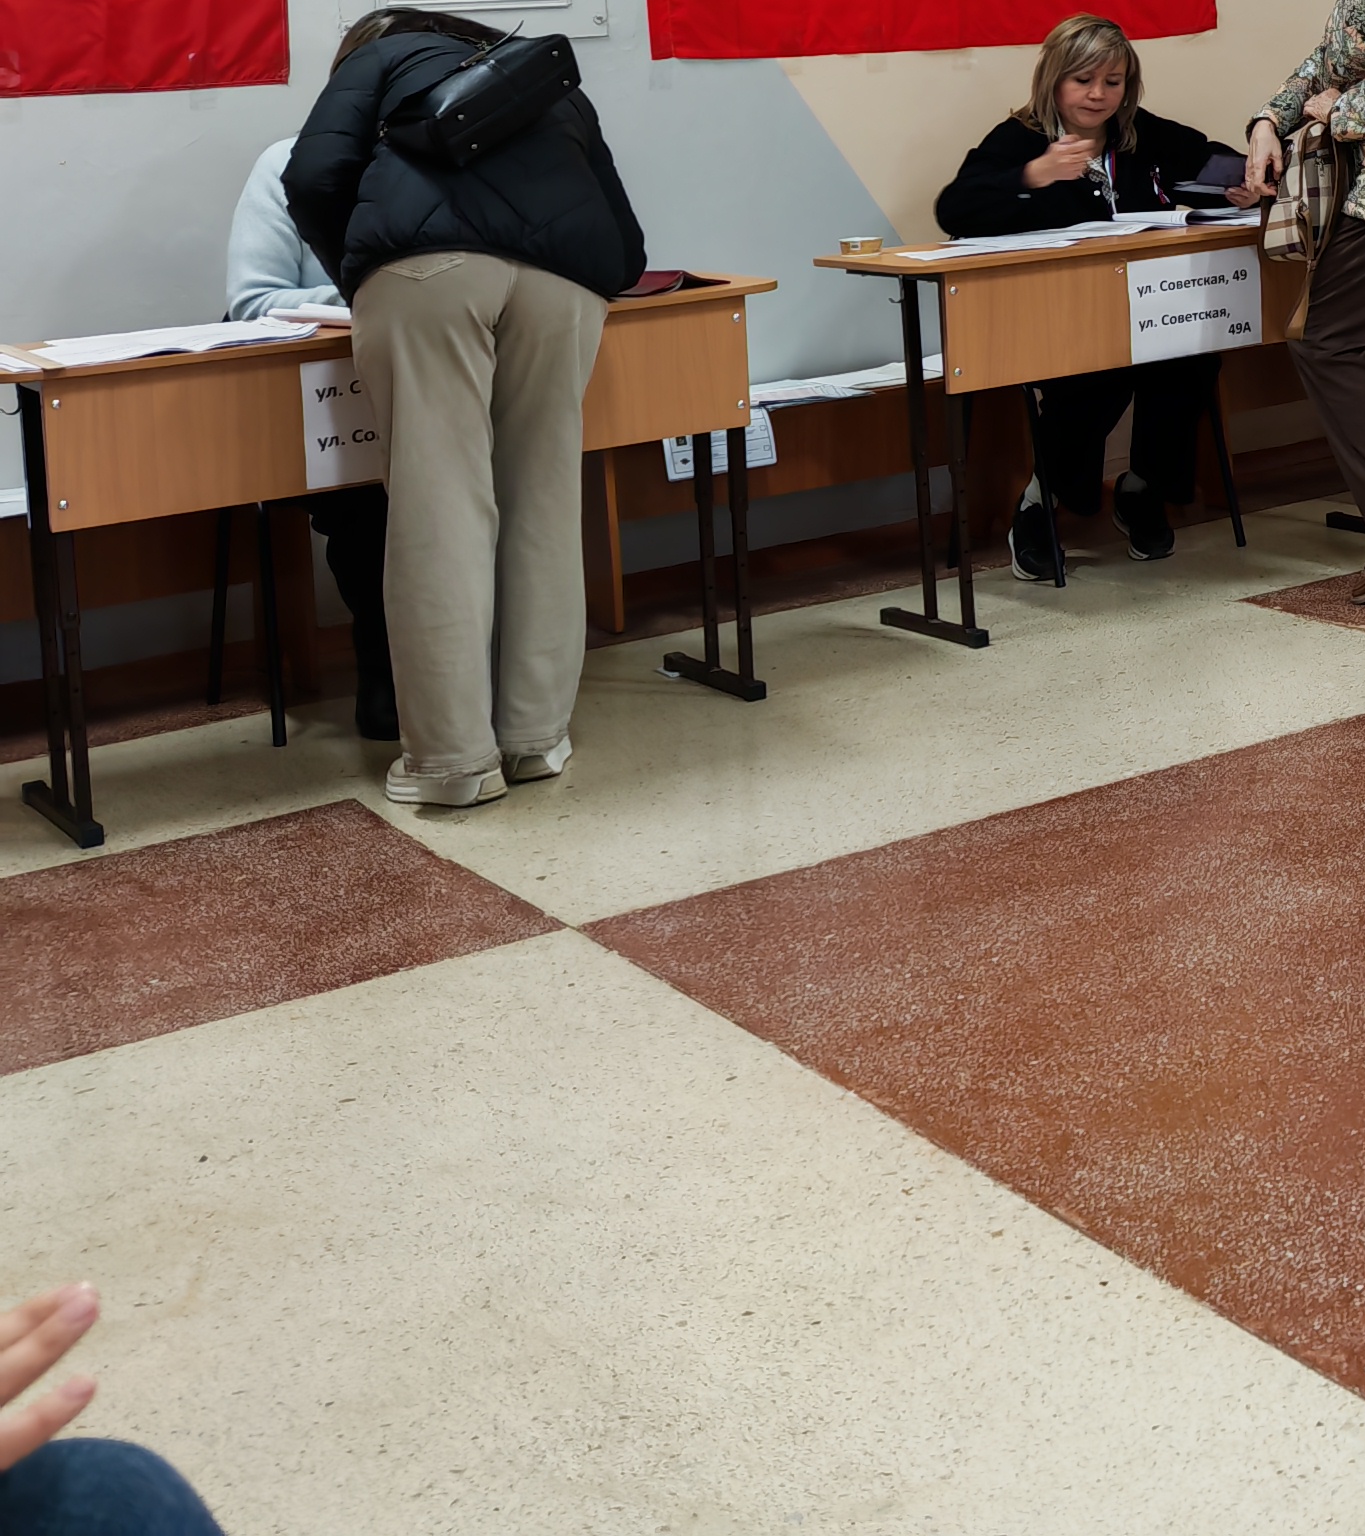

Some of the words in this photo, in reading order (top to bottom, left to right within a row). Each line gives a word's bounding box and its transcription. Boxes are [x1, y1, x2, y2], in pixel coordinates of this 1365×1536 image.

[1136, 284, 1156, 298] ул.
[1160, 272, 1229, 292] Советская,
[1232, 269, 1248, 282] 49
[1138, 319, 1158, 332] ул.
[1161, 307, 1231, 326] Советская,
[1228, 321, 1252, 335] 49А
[315, 385, 343, 403] ул.
[350, 379, 362, 394] С
[317, 435, 346, 452] ул.
[352, 428, 380, 443] Со
